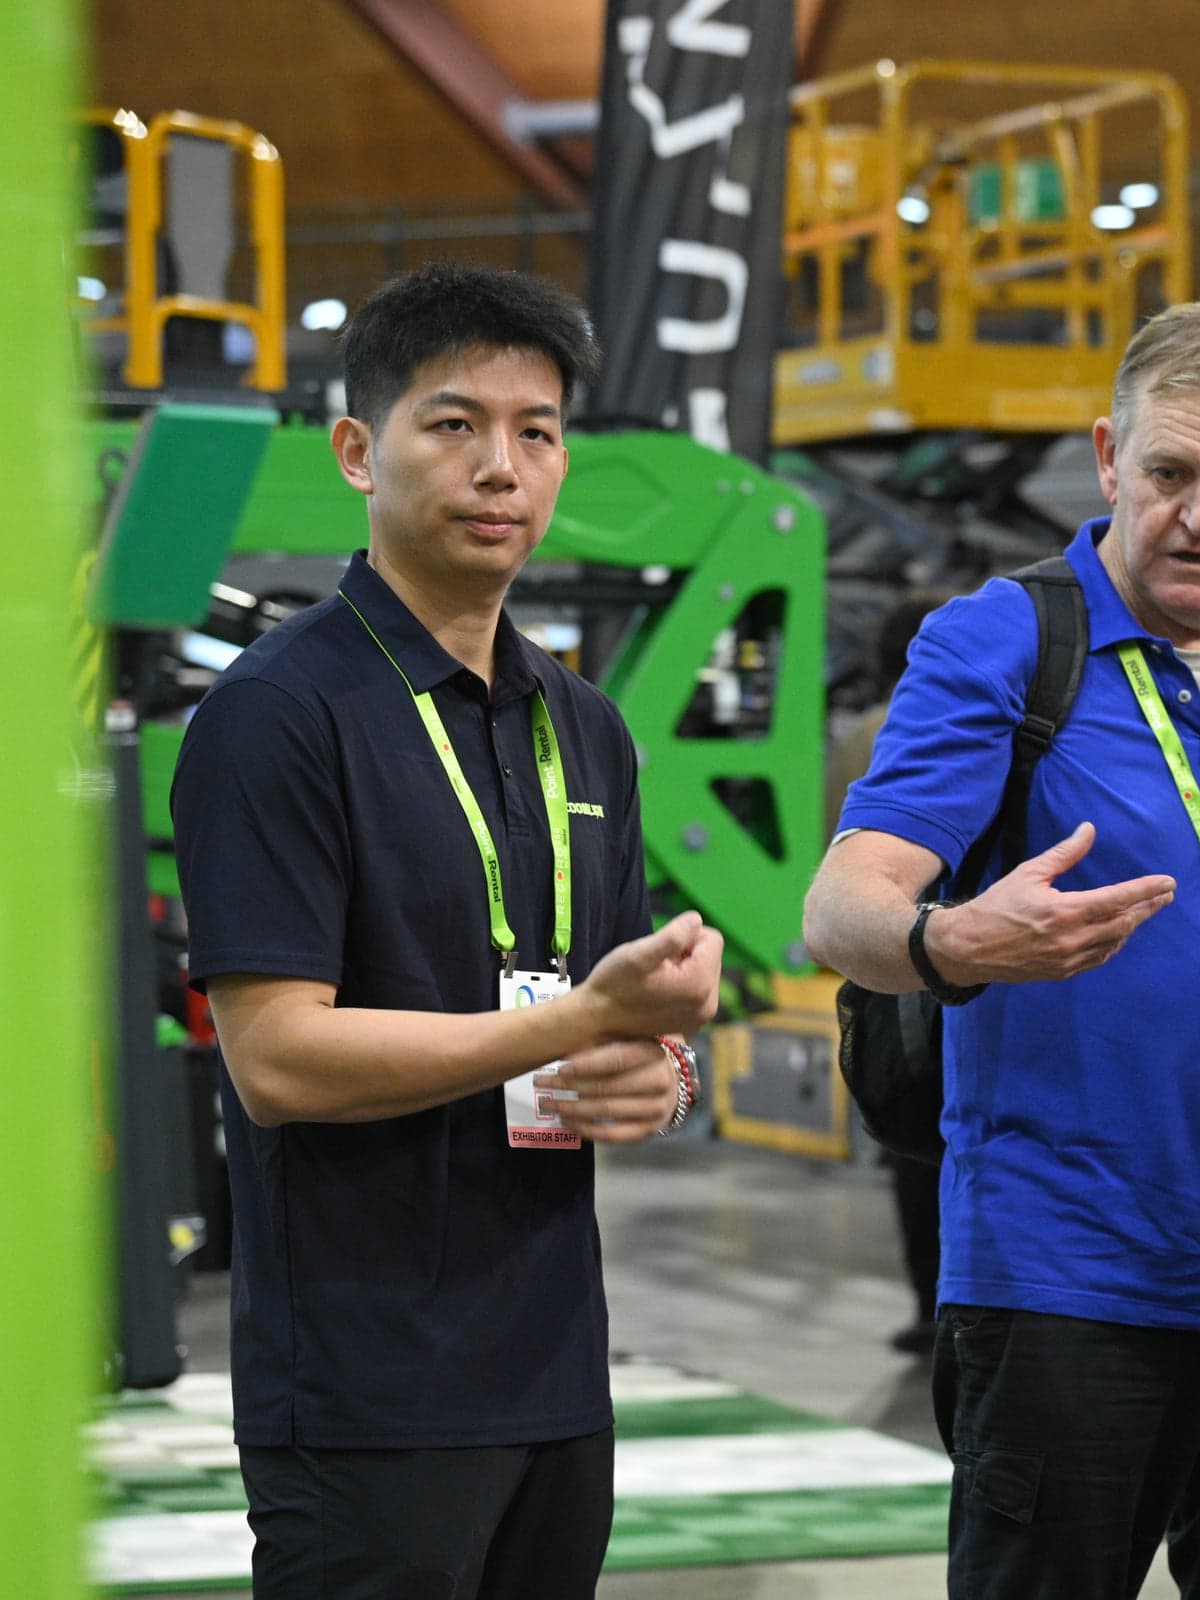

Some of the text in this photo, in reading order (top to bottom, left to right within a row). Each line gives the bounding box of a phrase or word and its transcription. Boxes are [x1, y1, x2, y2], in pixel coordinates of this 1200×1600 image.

[1126, 660, 1149, 696] Rental
[535, 725, 551, 763] Rental
[488, 859, 501, 903] Rental
[512, 1131, 577, 1143] EXHIBITOR STAFF
